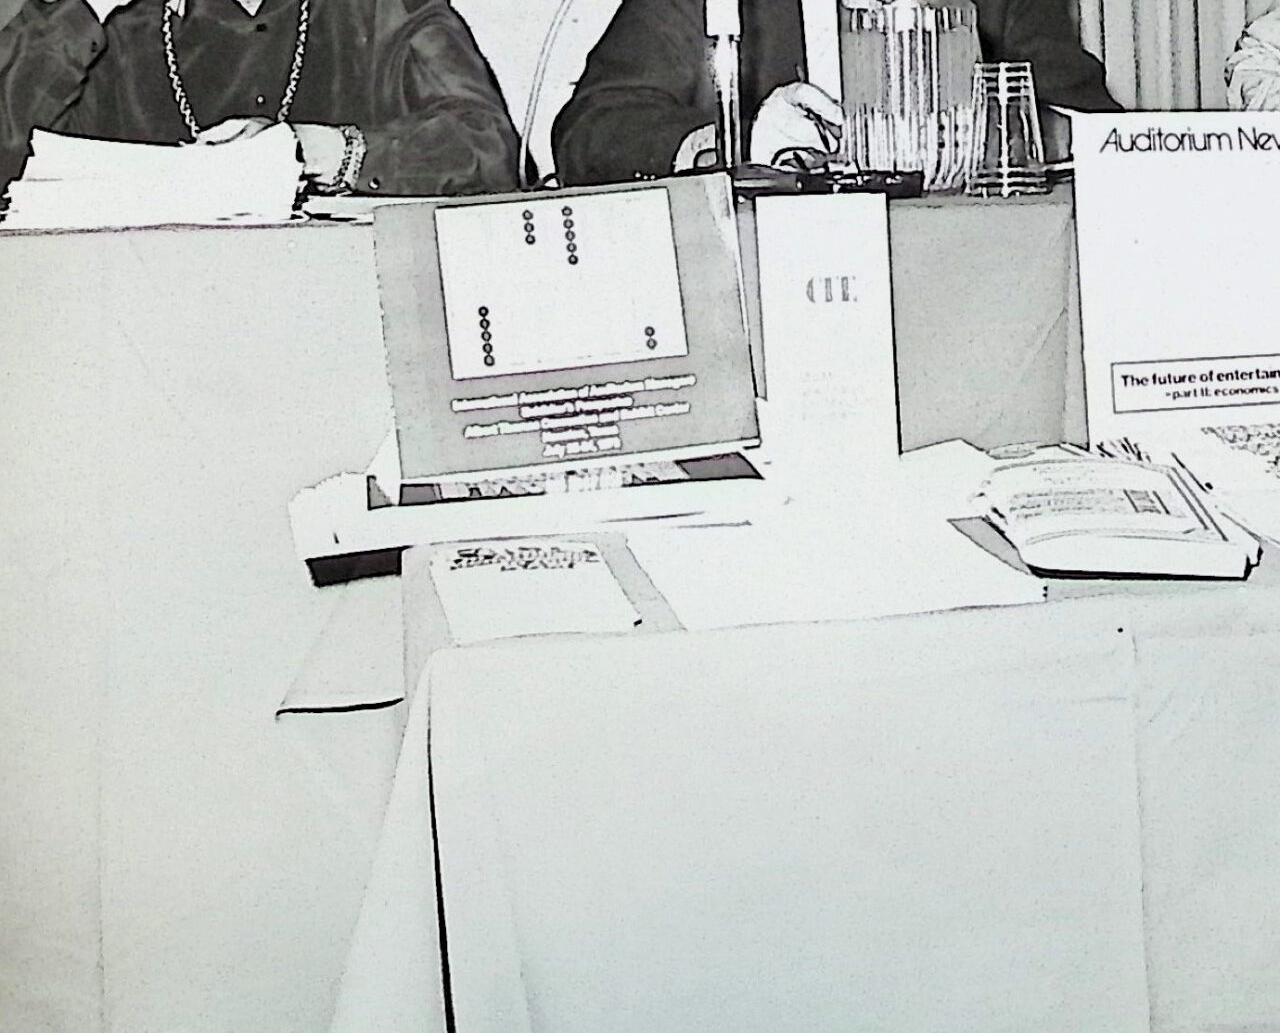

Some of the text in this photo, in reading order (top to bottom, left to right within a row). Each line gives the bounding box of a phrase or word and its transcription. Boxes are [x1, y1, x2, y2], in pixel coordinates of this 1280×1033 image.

[1099, 127, 1232, 153] Auditorium
[1121, 374, 1149, 387] The
[1152, 372, 1197, 385] future
[1199, 370, 1214, 383] of
[1213, 384, 1280, 397] economics
